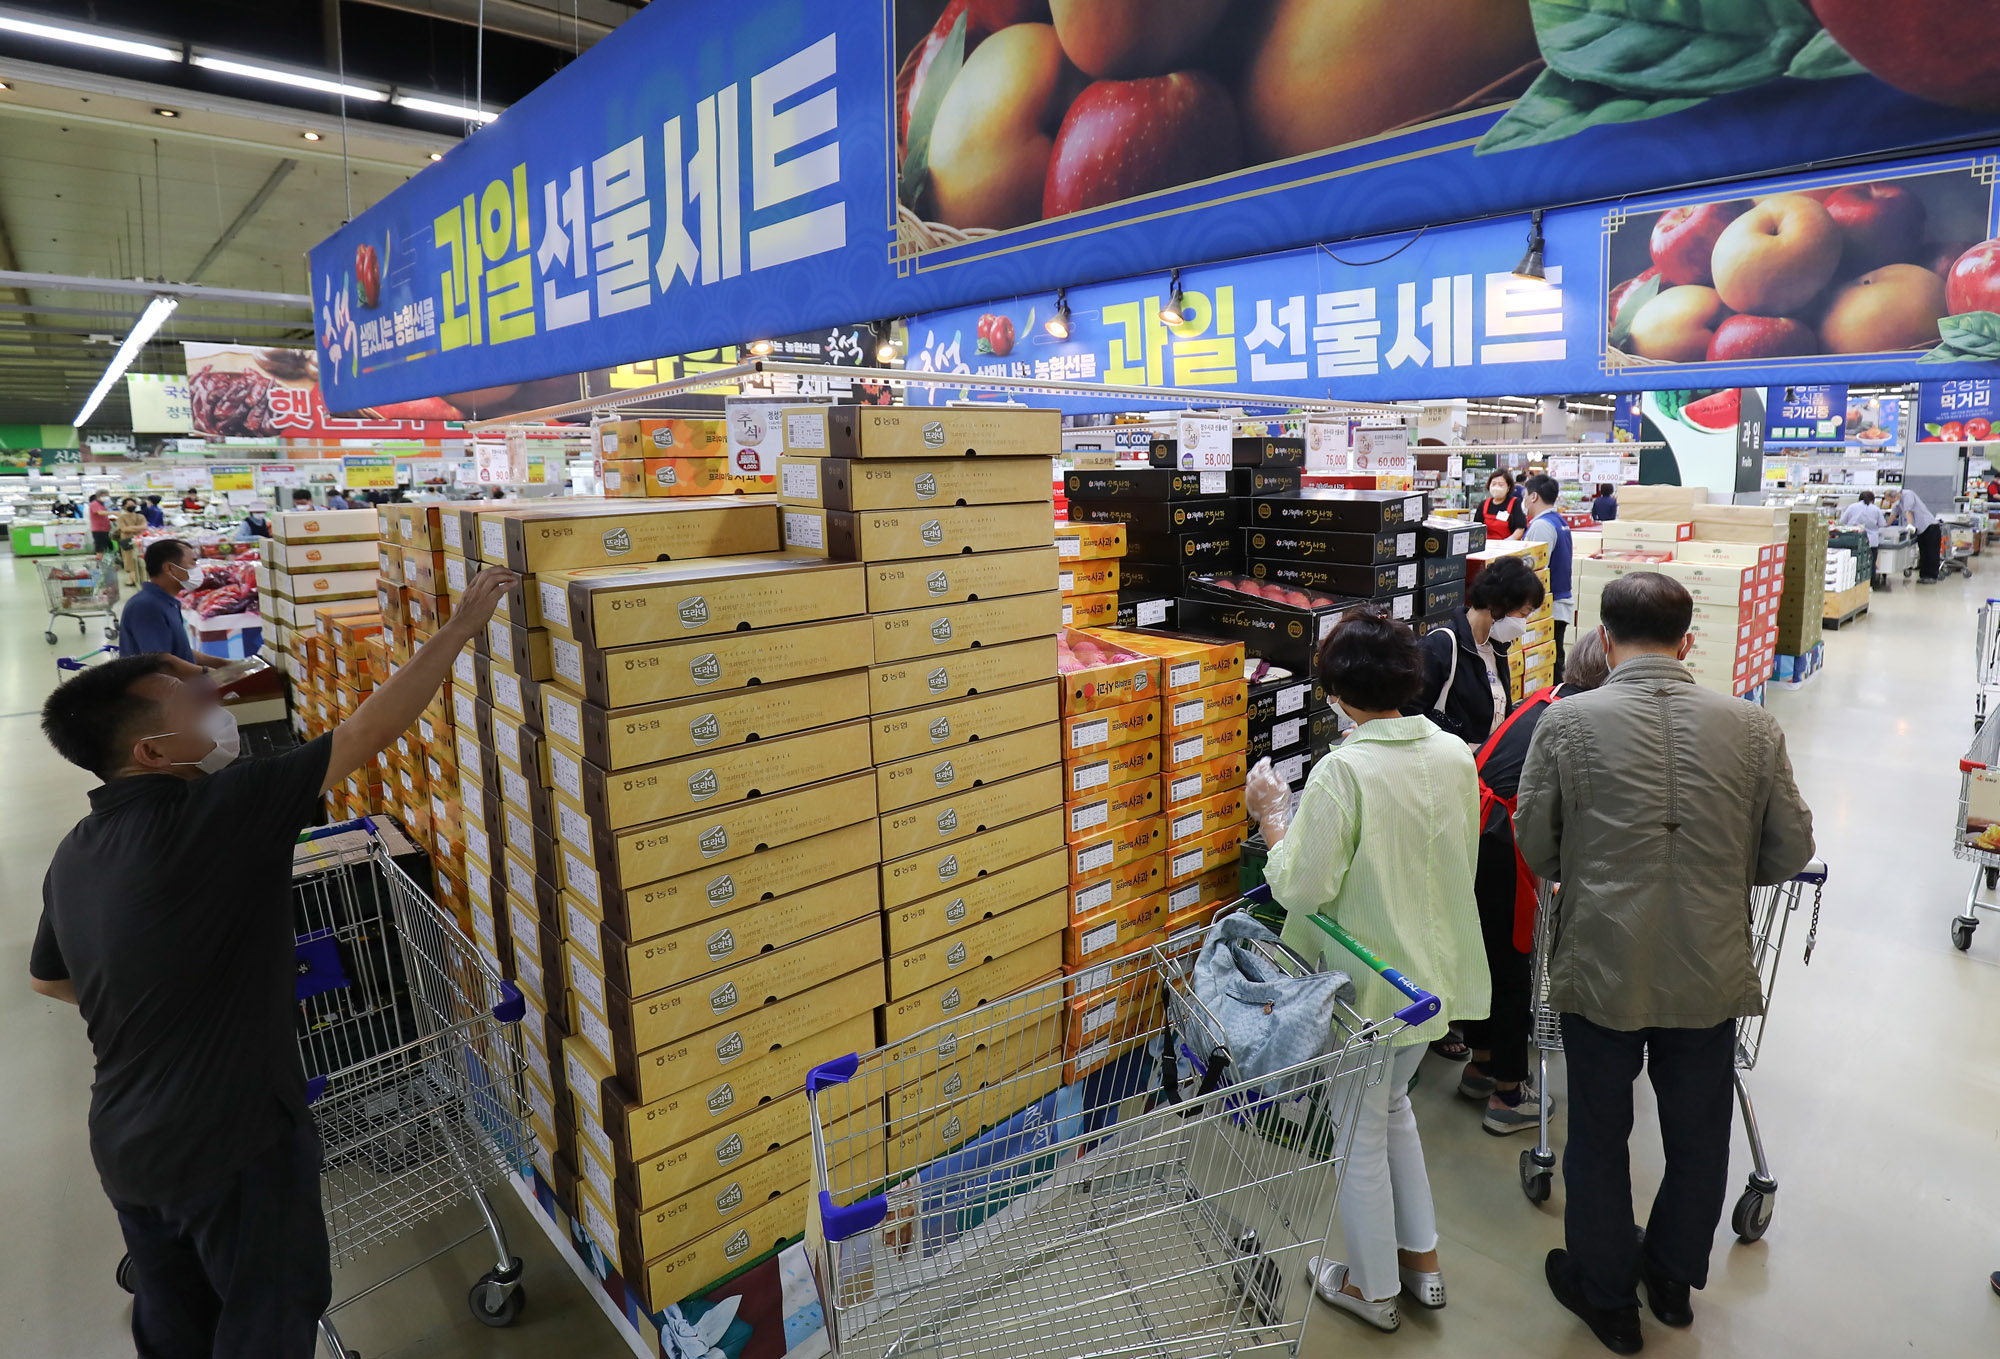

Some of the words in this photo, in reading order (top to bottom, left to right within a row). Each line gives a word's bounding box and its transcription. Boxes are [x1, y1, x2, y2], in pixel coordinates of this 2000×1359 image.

[537, 32, 848, 332] 선물세트
[322, 273, 359, 386] 추석
[360, 312, 394, 359] 살맛나는
[394, 297, 437, 350] 농협선물
[1244, 265, 1567, 383] 선물세트
[826, 327, 864, 366] 추석
[1941, 390, 1990, 410] 먹거리
[269, 387, 314, 430] 햇
[1783, 406, 1829, 419] 국가인증
[737, 411, 758, 441] 추석
[1742, 420, 1761, 449] 과일
[1204, 453, 1231, 467] 58,000
[1325, 454, 1347, 467] 76,000
[1378, 456, 1405, 468] 60,000
[1597, 474, 1619, 482] 69,000
[552, 528, 574, 540] 농협
[605, 534, 628, 548] 뜨라네
[1100, 537, 1112, 548] 사과
[1091, 572, 1105, 582] 사과
[625, 598, 647, 608] 농협
[1091, 604, 1104, 616] 사과
[682, 603, 707, 619] 뜨라네
[639, 656, 660, 668] 농협
[1218, 658, 1232, 671] 사과
[694, 661, 718, 678] 뜨라네
[1096, 680, 1114, 695] 사과
[1220, 694, 1234, 708] 사과
[639, 718, 660, 730] 농협
[1129, 715, 1145, 729] 사과
[694, 722, 718, 739] 뜨라네
[1220, 730, 1234, 744] 사과
[1129, 755, 1145, 768] 사과
[1219, 767, 1233, 780] 사과
[636, 775, 658, 788] 농협
[692, 776, 716, 791] 뜨라네
[1129, 792, 1144, 808] 사과
[1220, 803, 1234, 816] 사과
[648, 834, 669, 847] 농협
[702, 833, 727, 849] 뜨라네
[1134, 832, 1150, 848] 사과
[1220, 839, 1234, 854] 사과
[1132, 870, 1149, 886] 사과
[656, 886, 678, 899] 농협
[710, 881, 734, 897] 뜨라네
[1136, 910, 1153, 926] 사과
[656, 941, 678, 954] 농협
[710, 935, 734, 951] 뜨라네
[660, 996, 681, 1010] 농협
[713, 990, 737, 1005] 뜨라네
[668, 1047, 688, 1061] 농협
[719, 1040, 742, 1055] 뜨라네
[710, 1091, 734, 1106] 뜨라네
[658, 1100, 679, 1114] 농협
[719, 1142, 742, 1157] 뜨라네
[667, 1151, 688, 1165] 농협
[719, 1191, 742, 1206] 뜨라네
[667, 1201, 688, 1215] 농협
[727, 1237, 751, 1254] 뜨라네
[676, 1250, 697, 1265] 농협
